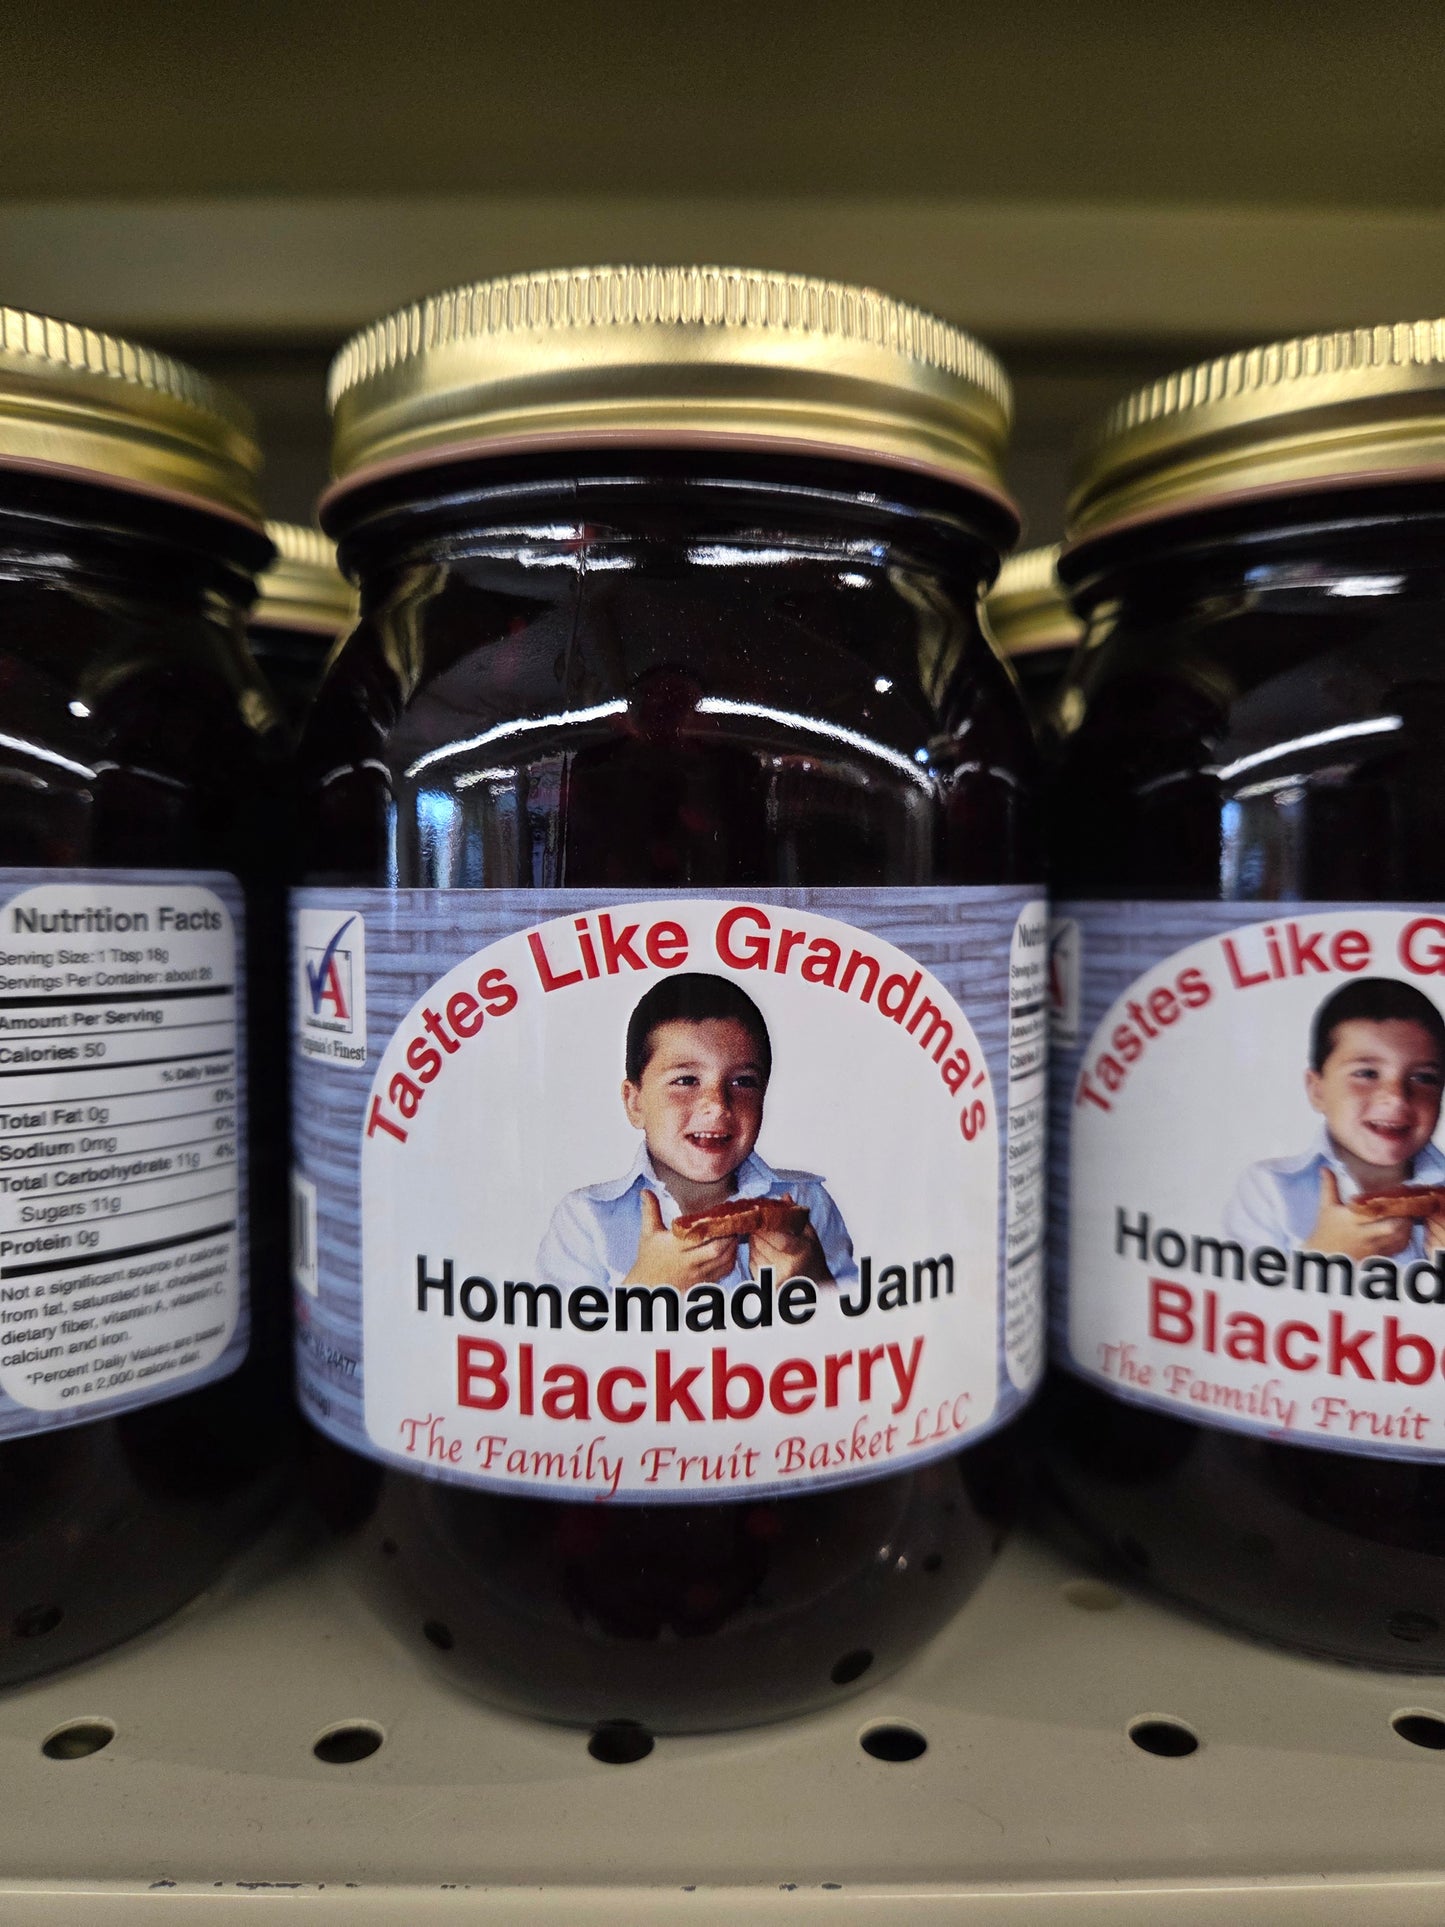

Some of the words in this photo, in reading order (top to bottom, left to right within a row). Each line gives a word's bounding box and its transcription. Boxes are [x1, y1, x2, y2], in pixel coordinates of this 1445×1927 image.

[14, 906, 149, 934] Nutrition
[159, 905, 222, 932] Facts
[0, 951, 53, 967] Serving
[59, 950, 94, 964] Size:
[100, 951, 106, 963] 1
[111, 949, 143, 964] Tbsp
[147, 949, 169, 963] 18g
[0, 975, 63, 991] Servings
[68, 973, 91, 987] Per
[97, 971, 163, 985] Container:
[166, 969, 198, 982] about
[0, 1014, 68, 1030] Amount
[74, 1012, 101, 1027] Per
[106, 1008, 163, 1025] Serving
[366, 966, 519, 1144] Tastes
[526, 913, 689, 993] Like
[715, 905, 992, 1143] Grandma's
[1076, 966, 1214, 1114] Tastes
[1221, 922, 1371, 990] Like
[0, 1045, 79, 1064] Calories
[84, 1042, 106, 1058] 50
[334, 1041, 366, 1061] Finest
[0, 1111, 47, 1130] Total
[54, 1108, 84, 1124] Fat
[89, 1106, 110, 1123] 0g
[215, 1088, 235, 1103] 0%
[0, 1140, 75, 1162] Sodium
[81, 1136, 117, 1153] 0mg
[215, 1116, 235, 1131] 0%
[0, 1173, 48, 1193] Total
[54, 1156, 173, 1188] Carbohydrate
[177, 1151, 200, 1169] 11g
[21, 1201, 87, 1223] Sugars
[92, 1196, 121, 1213] 11g
[1, 1234, 72, 1256] Protein
[78, 1229, 99, 1246] 0g
[1115, 1205, 1445, 1304] Homemad
[1, 1287, 30, 1302] Not
[35, 1286, 45, 1297] a
[50, 1268, 124, 1295] significant
[416, 1252, 818, 1333] Homemade
[838, 1252, 955, 1319] Jam
[1, 1309, 38, 1325] from
[43, 1303, 68, 1317] fat,
[73, 1287, 140, 1312] saturated
[1, 1325, 56, 1347] dietary
[61, 1317, 98, 1335] fiber,
[103, 1305, 150, 1327] vitamin
[1148, 1275, 1445, 1386] Blackb
[2, 1345, 65, 1367] calcium
[68, 1337, 97, 1355] and
[101, 1329, 132, 1346] iron.
[93, 1352, 128, 1372] Daily
[61, 1384, 79, 1399] on
[96, 1369, 135, 1391] 2,000
[456, 1333, 926, 1424] Blackberry
[1097, 1340, 1153, 1387] The
[1163, 1363, 1297, 1439] Family
[1311, 1395, 1431, 1441] Fruit
[399, 1413, 464, 1463] The
[475, 1434, 624, 1503] Family
[640, 1444, 762, 1485] Fruit
[773, 1415, 899, 1475] Basket
[905, 1391, 972, 1447] LLC
